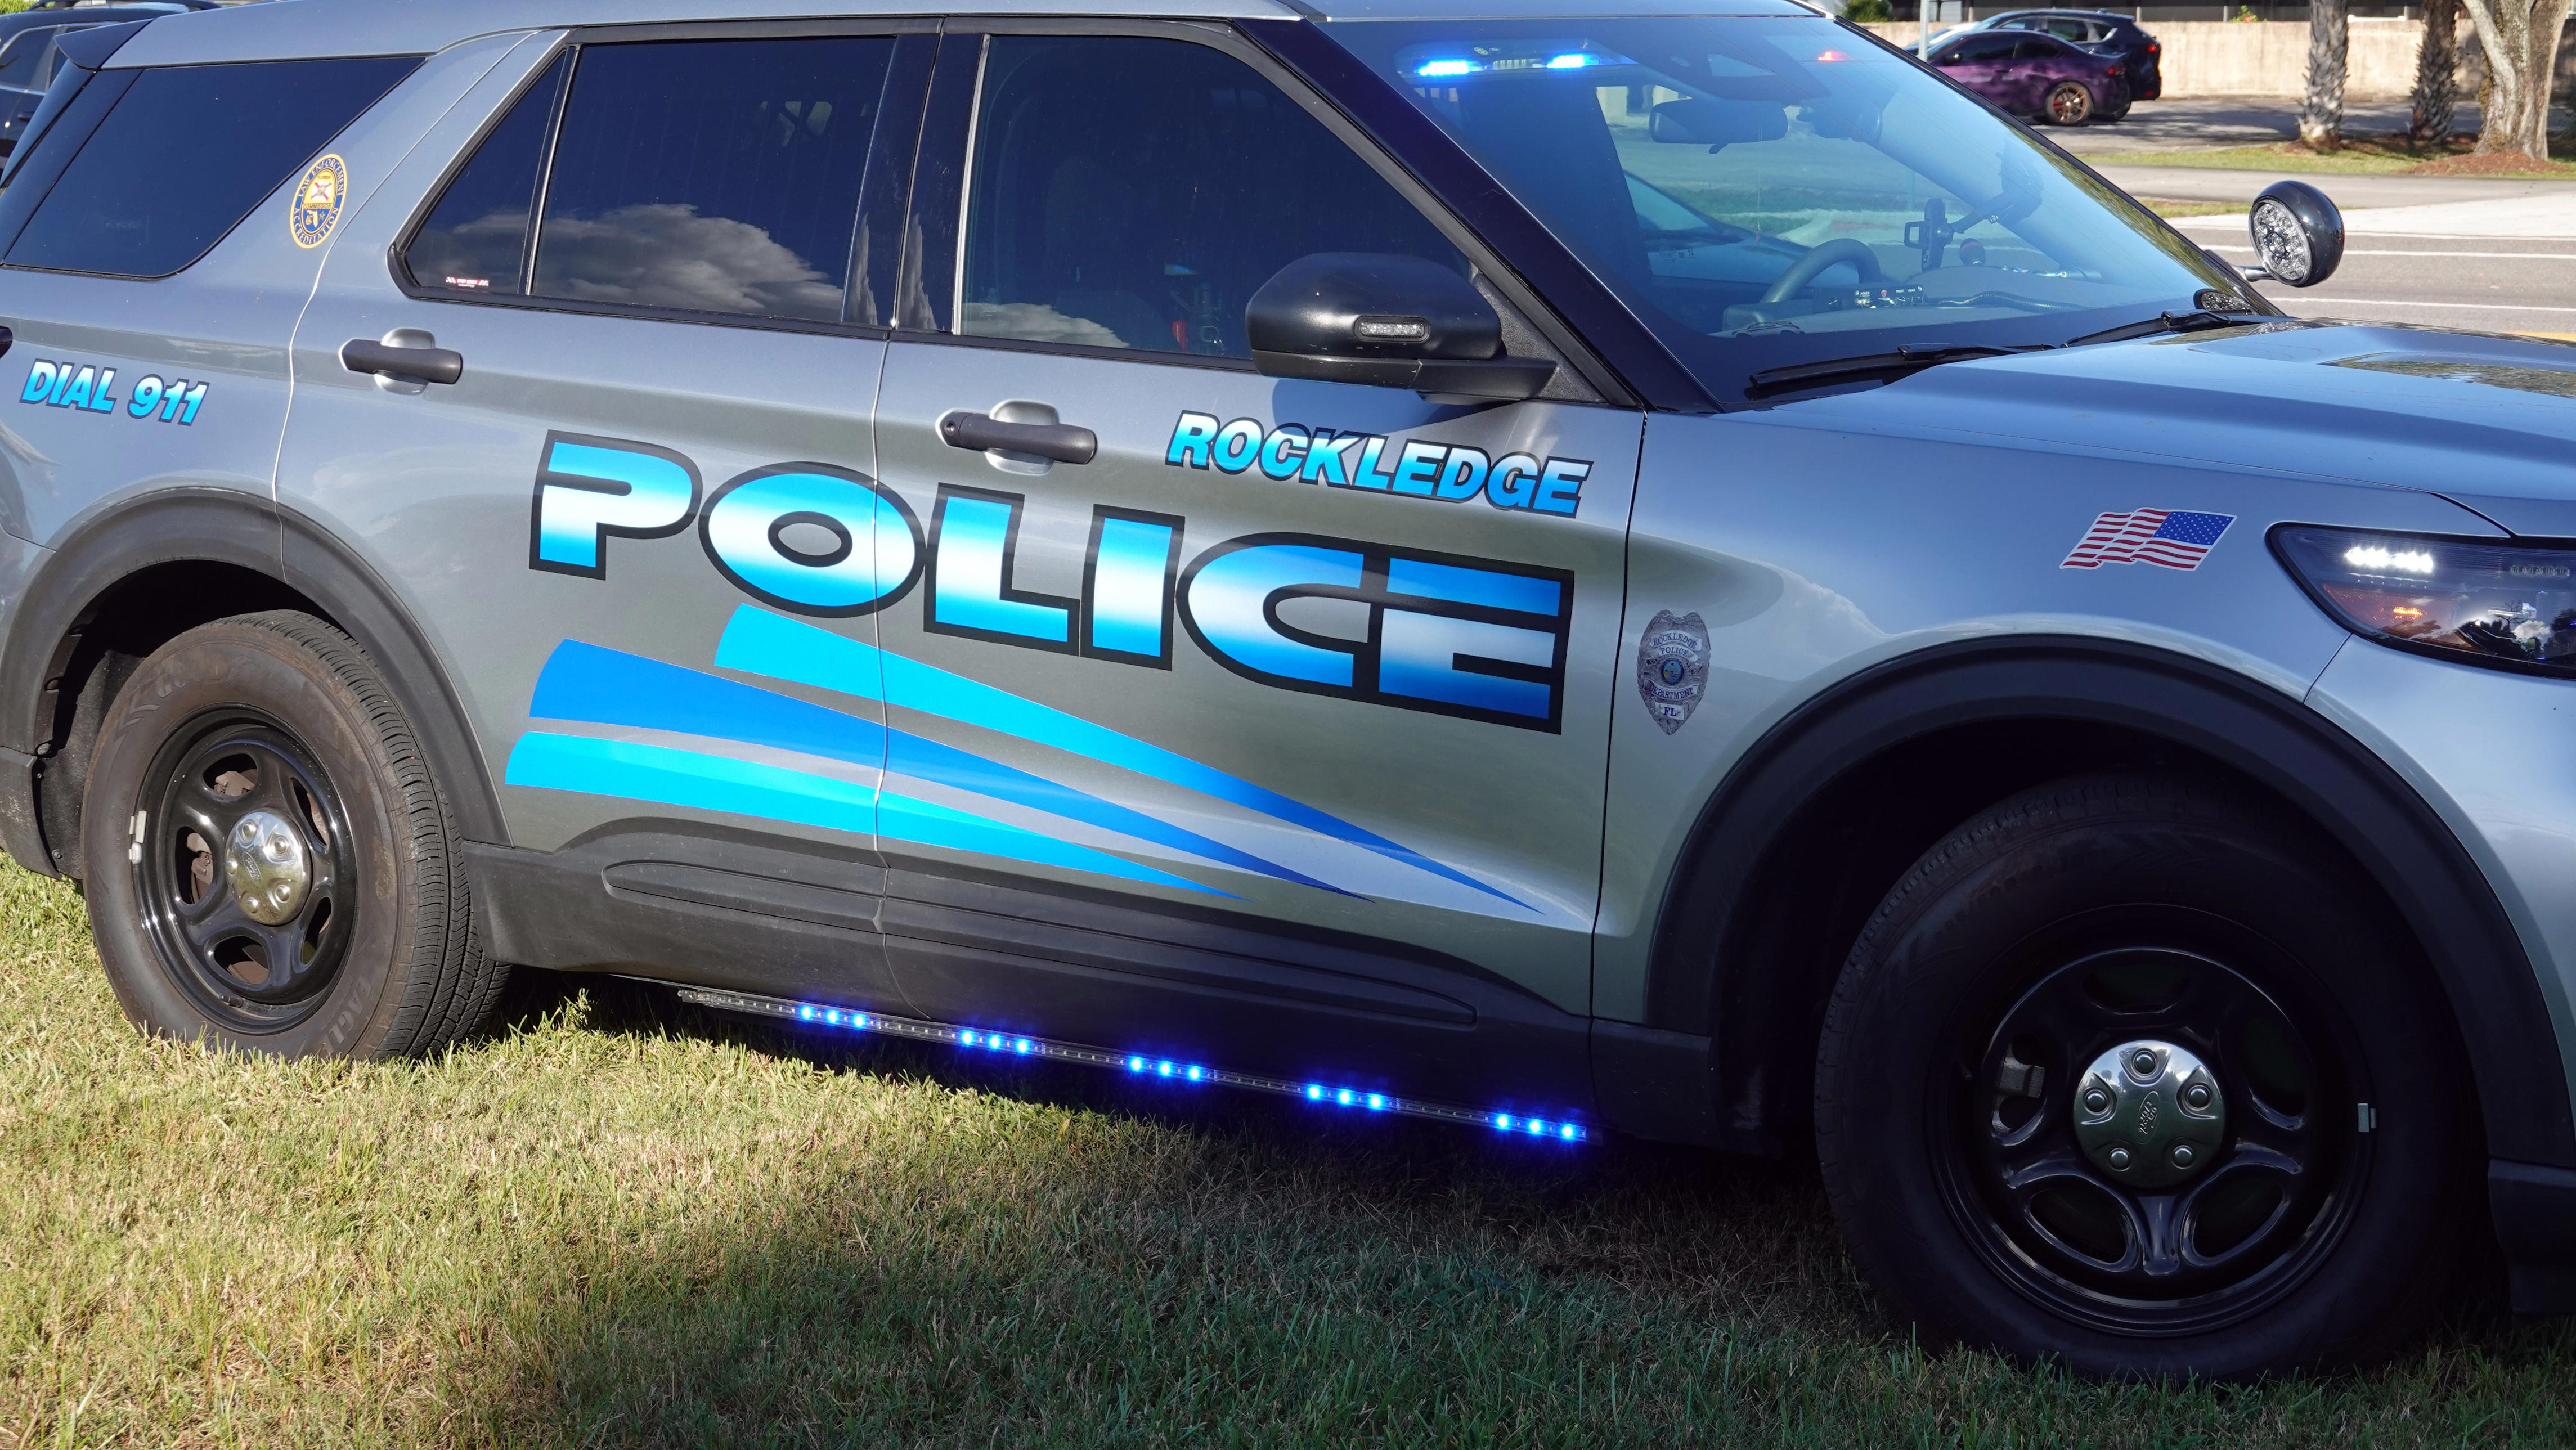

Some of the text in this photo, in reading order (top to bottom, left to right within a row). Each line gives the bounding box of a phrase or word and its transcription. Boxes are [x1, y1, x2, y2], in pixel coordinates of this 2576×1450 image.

[298, 158, 344, 197] LAW ENFORCEMENT
[293, 208, 339, 244] ACCREDITATION
[19, 358, 210, 426] DIAL 911
[1165, 410, 1594, 518] ROCKLEDGE
[529, 429, 1574, 735] POLICE
[1653, 632, 1697, 649] ROCKLEDGE
[1661, 647, 1688, 657] POLICE
[1649, 685, 1693, 699] DEPARTMENT
[1663, 707, 1677, 717] FL
